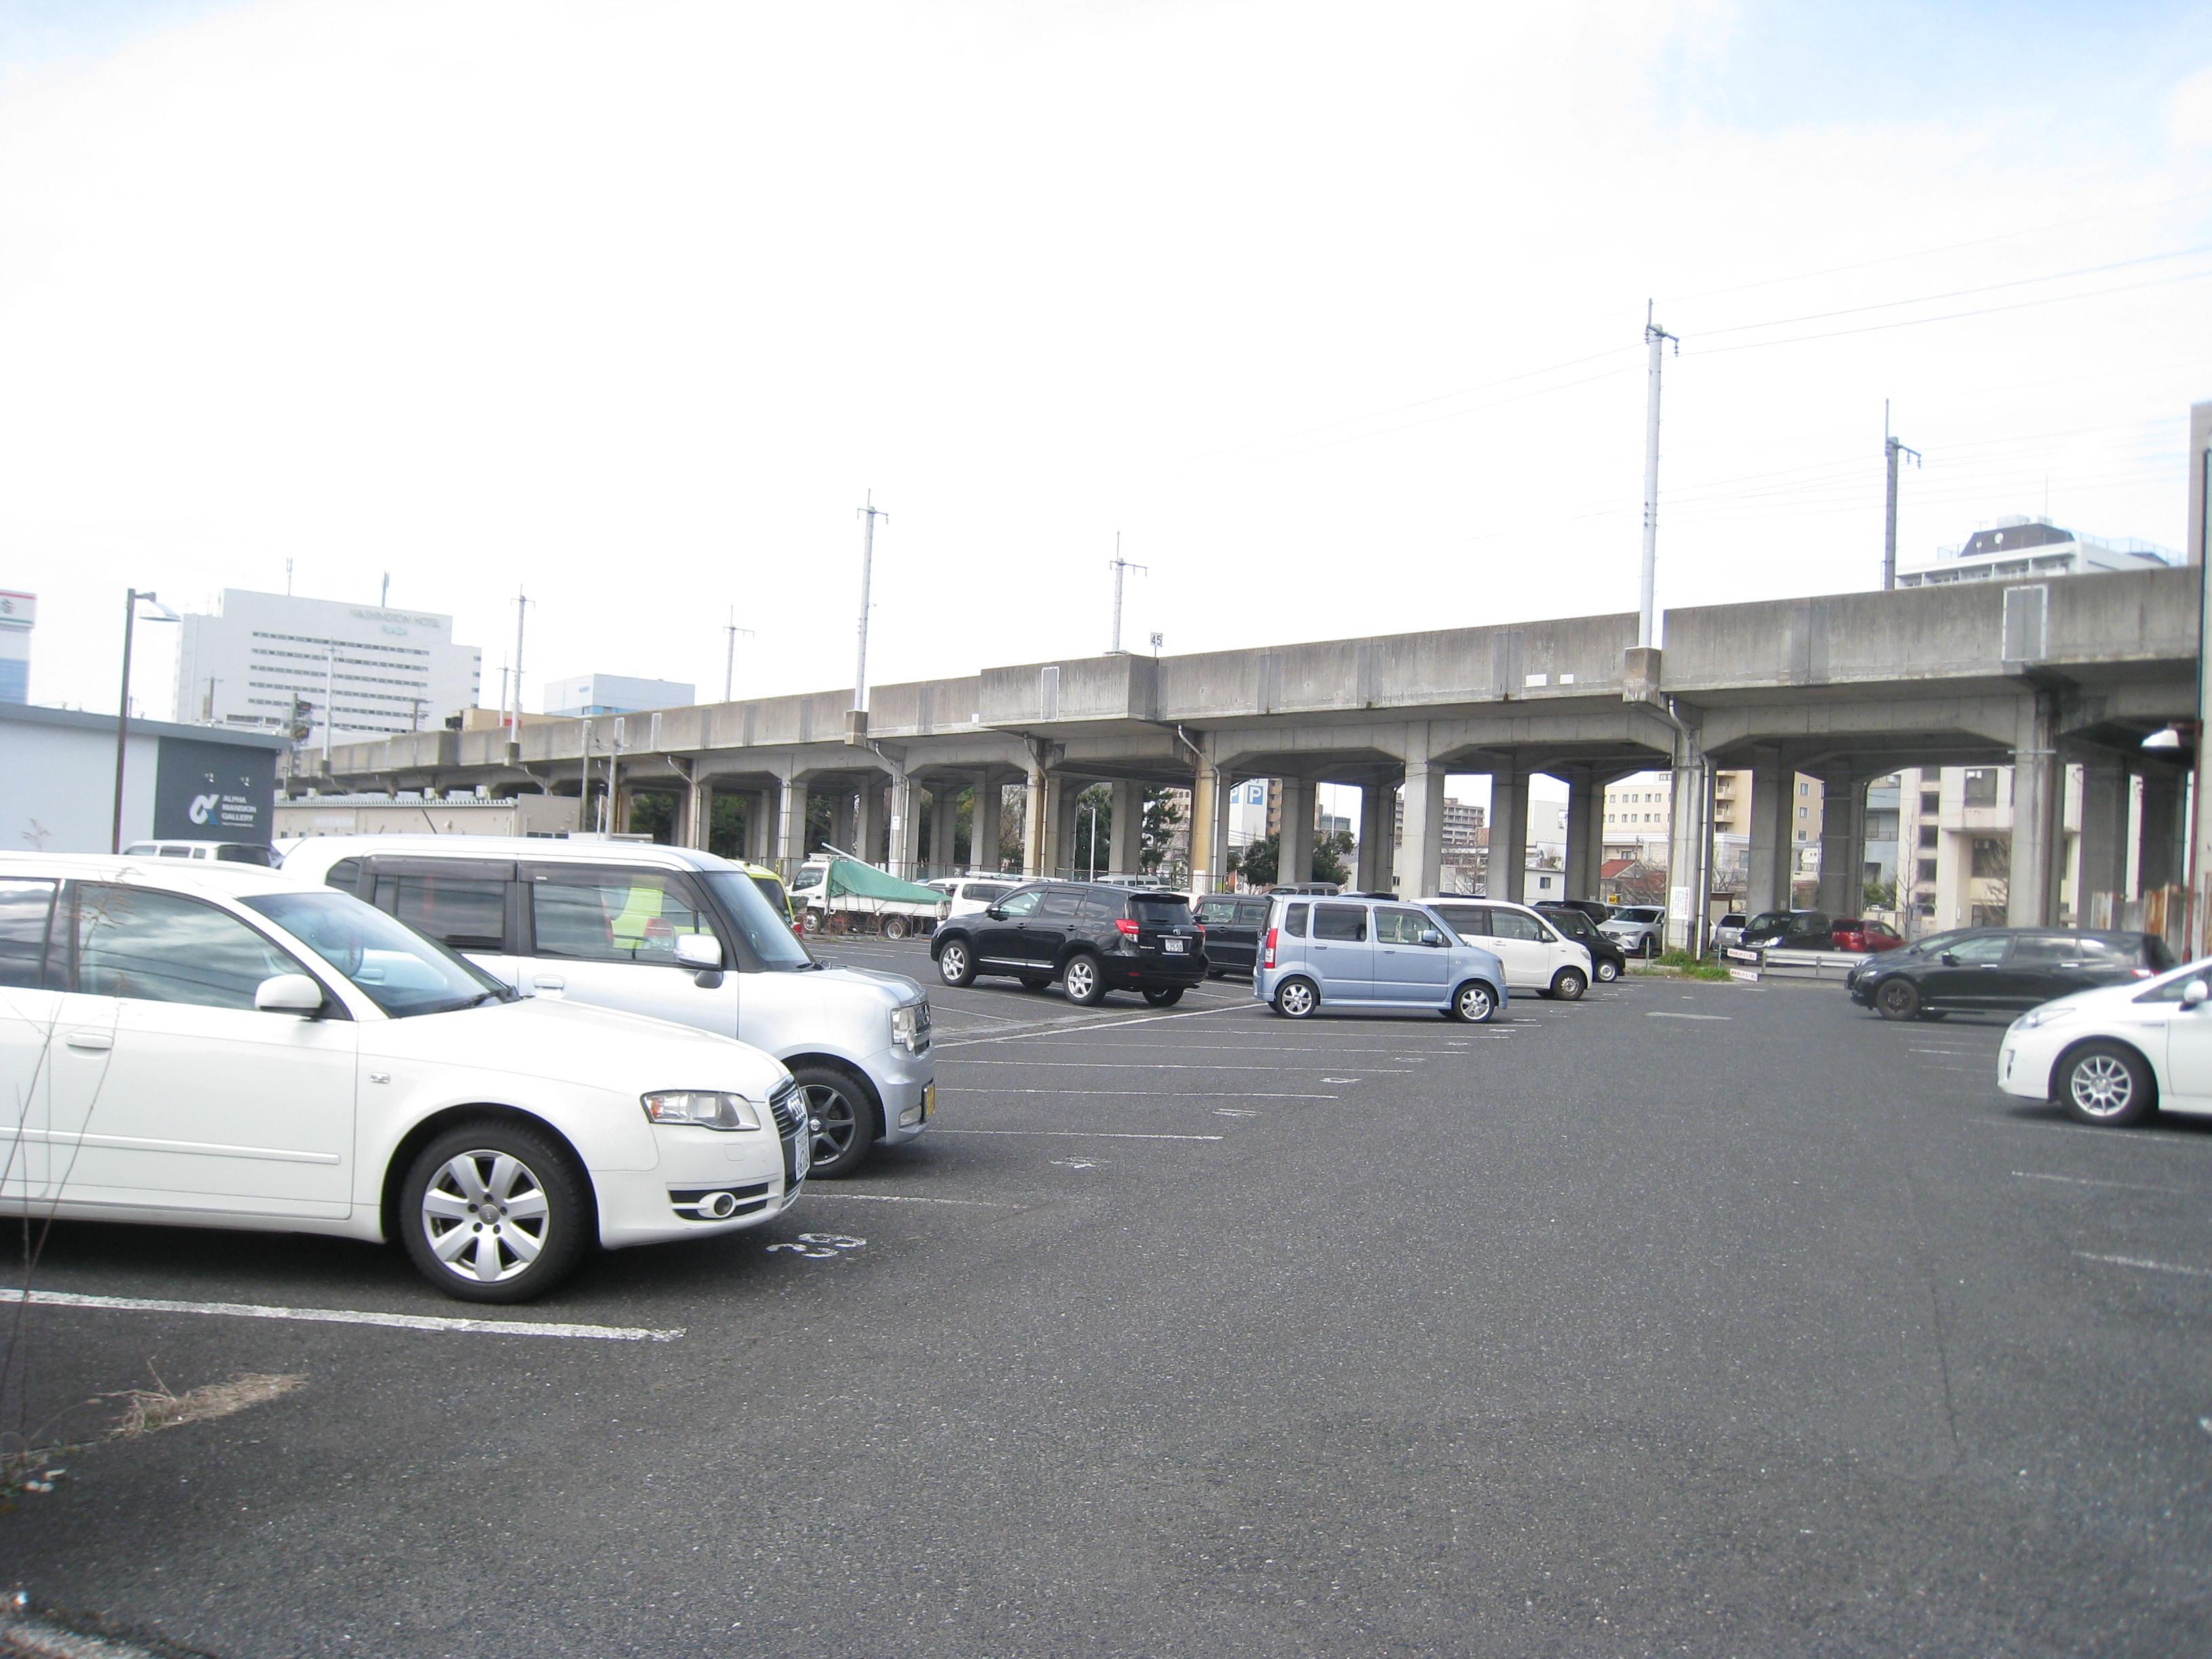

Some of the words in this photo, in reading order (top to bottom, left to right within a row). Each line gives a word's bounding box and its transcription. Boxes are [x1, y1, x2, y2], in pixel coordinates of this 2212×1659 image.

[1151, 634, 1162, 646] 45
[222, 795, 247, 804] ALPHA
[1249, 786, 1262, 803] P
[222, 803, 257, 813] MANSION
[221, 813, 253, 821] GALLERY
